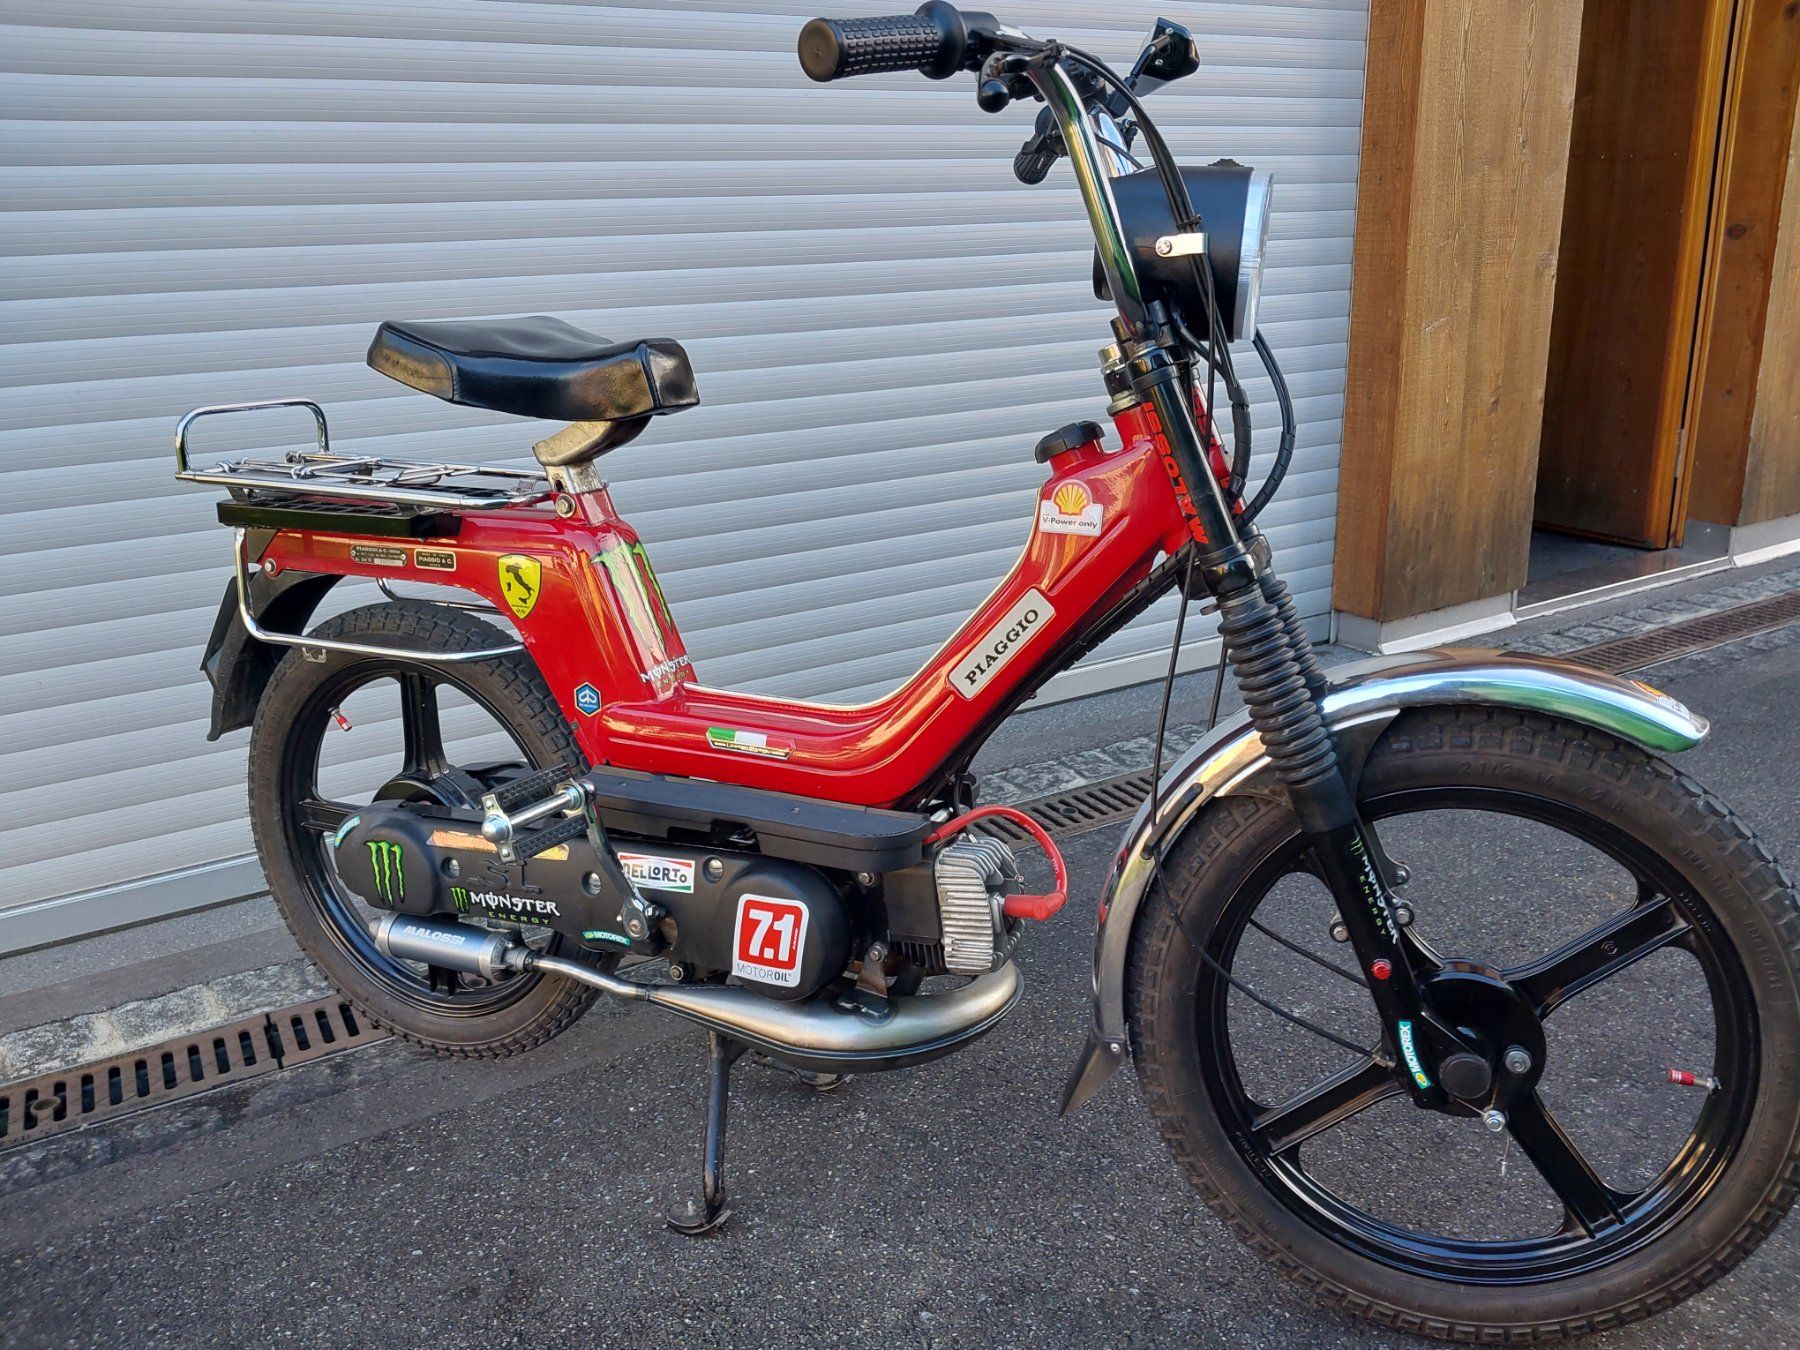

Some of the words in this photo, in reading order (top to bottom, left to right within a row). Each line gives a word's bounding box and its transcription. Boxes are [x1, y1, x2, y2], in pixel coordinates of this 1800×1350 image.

[1042, 516, 1077, 526] V-Power
[1079, 520, 1098, 529] only
[418, 556, 441, 564] PIAGGIO
[965, 609, 1039, 686] PIAGGIO
[640, 655, 690, 683] MONSTER
[622, 862, 688, 884] DELLORTO
[469, 891, 561, 917] MONSTER
[1359, 875, 1387, 935] ENERGY
[488, 911, 550, 925] ENERGY
[403, 925, 467, 946] MALOSSI
[748, 908, 796, 962] 7.1
[1400, 1025, 1422, 1073] MOTOREX
